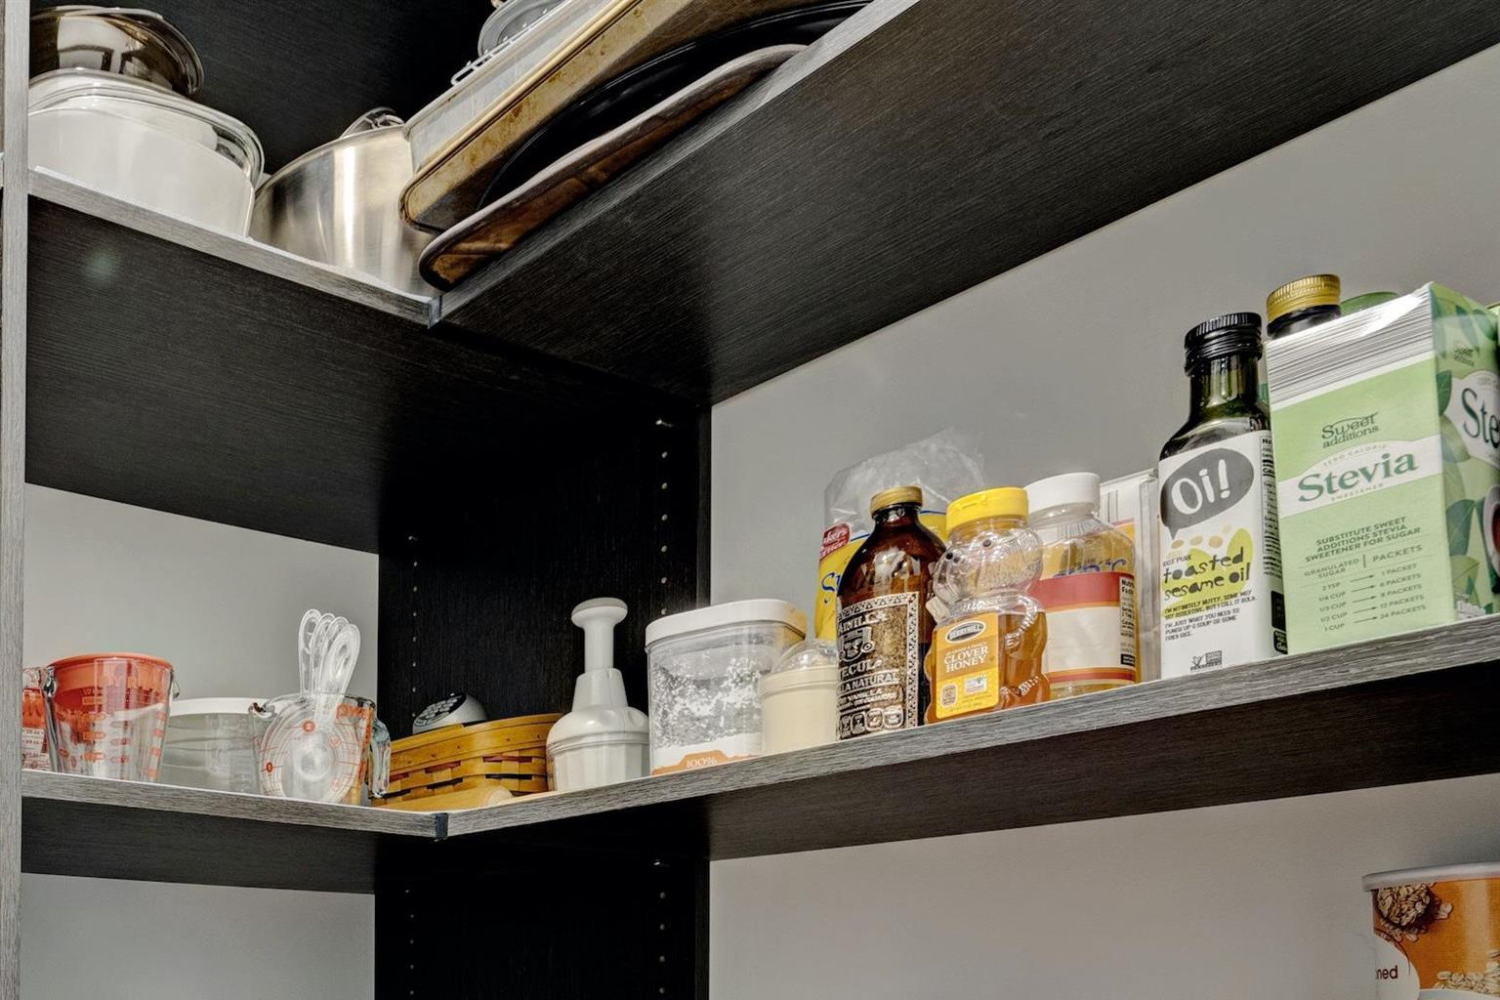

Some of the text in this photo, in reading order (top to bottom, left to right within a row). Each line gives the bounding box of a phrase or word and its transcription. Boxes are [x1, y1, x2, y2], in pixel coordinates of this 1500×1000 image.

[1321, 411, 1379, 440] Sweet
[1322, 425, 1380, 449] additions
[1171, 459, 1231, 515] Oi!
[1298, 452, 1419, 502] Stevia
[1305, 526, 1421, 562] SWEETENER FOR SUGAR
[1316, 516, 1407, 546] SUBSTITUTE SWEET
[1317, 523, 1408, 552] ADDITIONS STEVIA
[1162, 546, 1244, 584] toasted
[1372, 544, 1423, 562] PACKETS
[1304, 558, 1360, 577] GRANULATED
[1318, 567, 1346, 579] SUGAR
[1386, 563, 1417, 575] PACKET
[1164, 562, 1251, 601] sesame oil
[1330, 573, 1421, 600] CUP PACKETS
[1330, 583, 1422, 611] CUP PACKETS
[1331, 611, 1348, 621] CUP
[1389, 594, 1424, 607] PACKETS
[1390, 604, 1426, 617] PACKETS
[943, 645, 989, 665] CLOVER
[946, 656, 988, 673] HONEY
